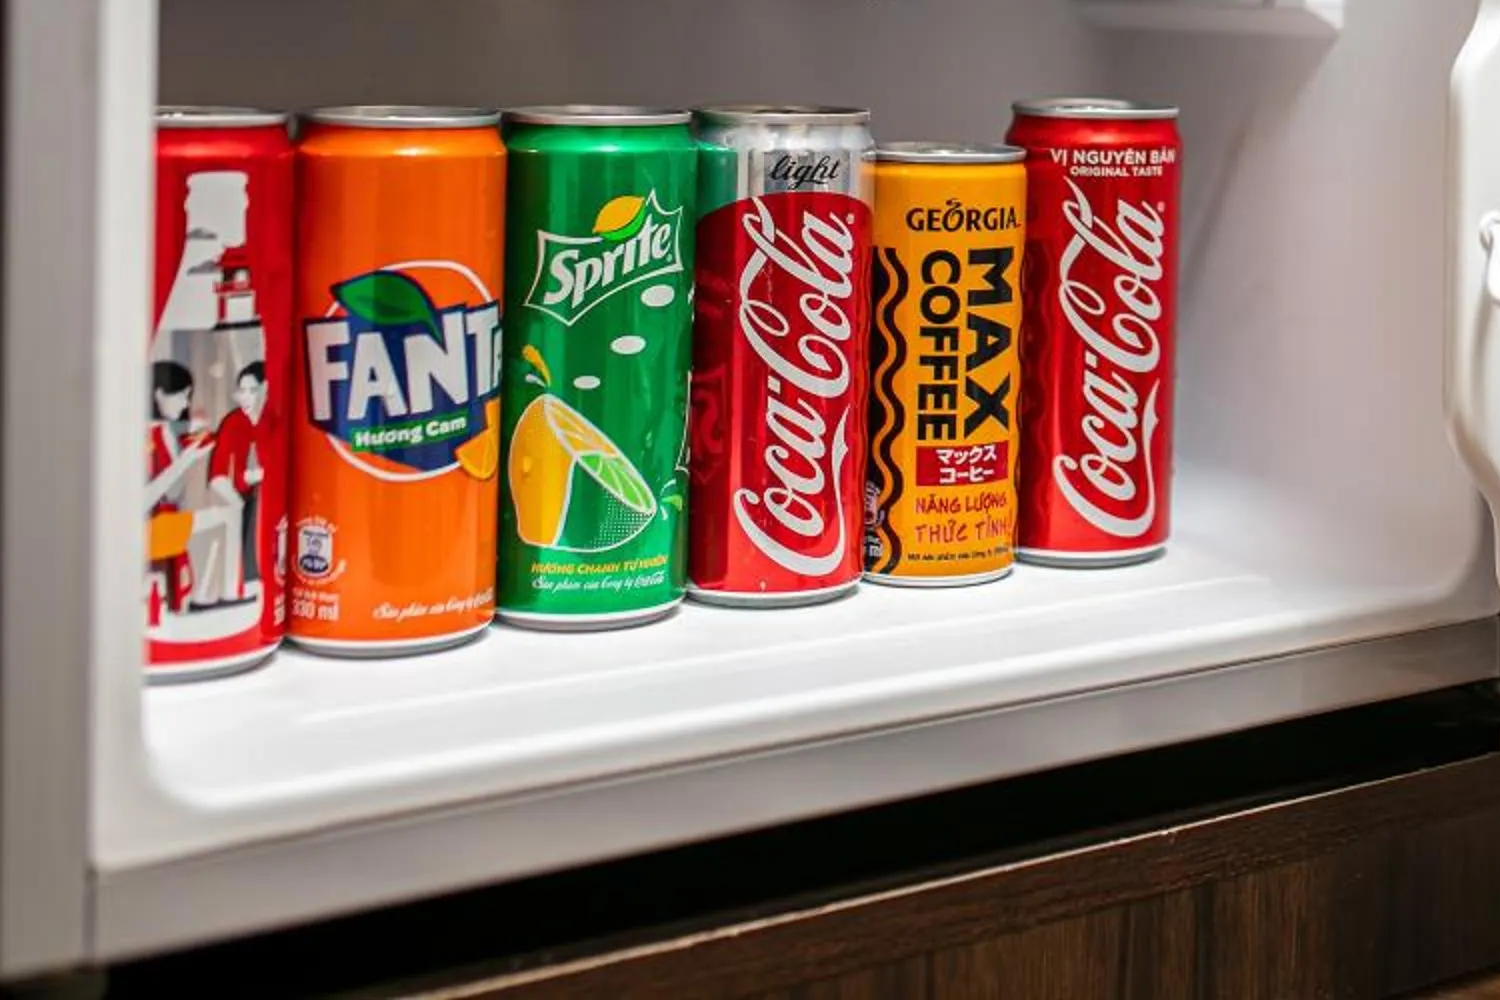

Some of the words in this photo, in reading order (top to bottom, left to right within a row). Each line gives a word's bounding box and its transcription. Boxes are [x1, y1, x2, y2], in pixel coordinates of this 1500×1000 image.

[770, 154, 841, 190] light
[1050, 148, 1068, 166] VỊ
[1073, 148, 1147, 164] NGUYÊN
[1070, 165, 1131, 177] ORIGINAL
[1132, 165, 1163, 177] TASTE
[906, 200, 1018, 232] GEORGIA
[543, 213, 671, 308] Sprite
[917, 250, 962, 440] COFFEE
[964, 246, 1015, 439] MAX
[1053, 175, 1166, 538] Coca-Cola
[734, 196, 854, 577] Coca-Cola
[354, 423, 423, 447] Hương
[425, 414, 467, 437] Cam
[936, 445, 997, 465] マックス
[939, 467, 995, 485] コーヒー
